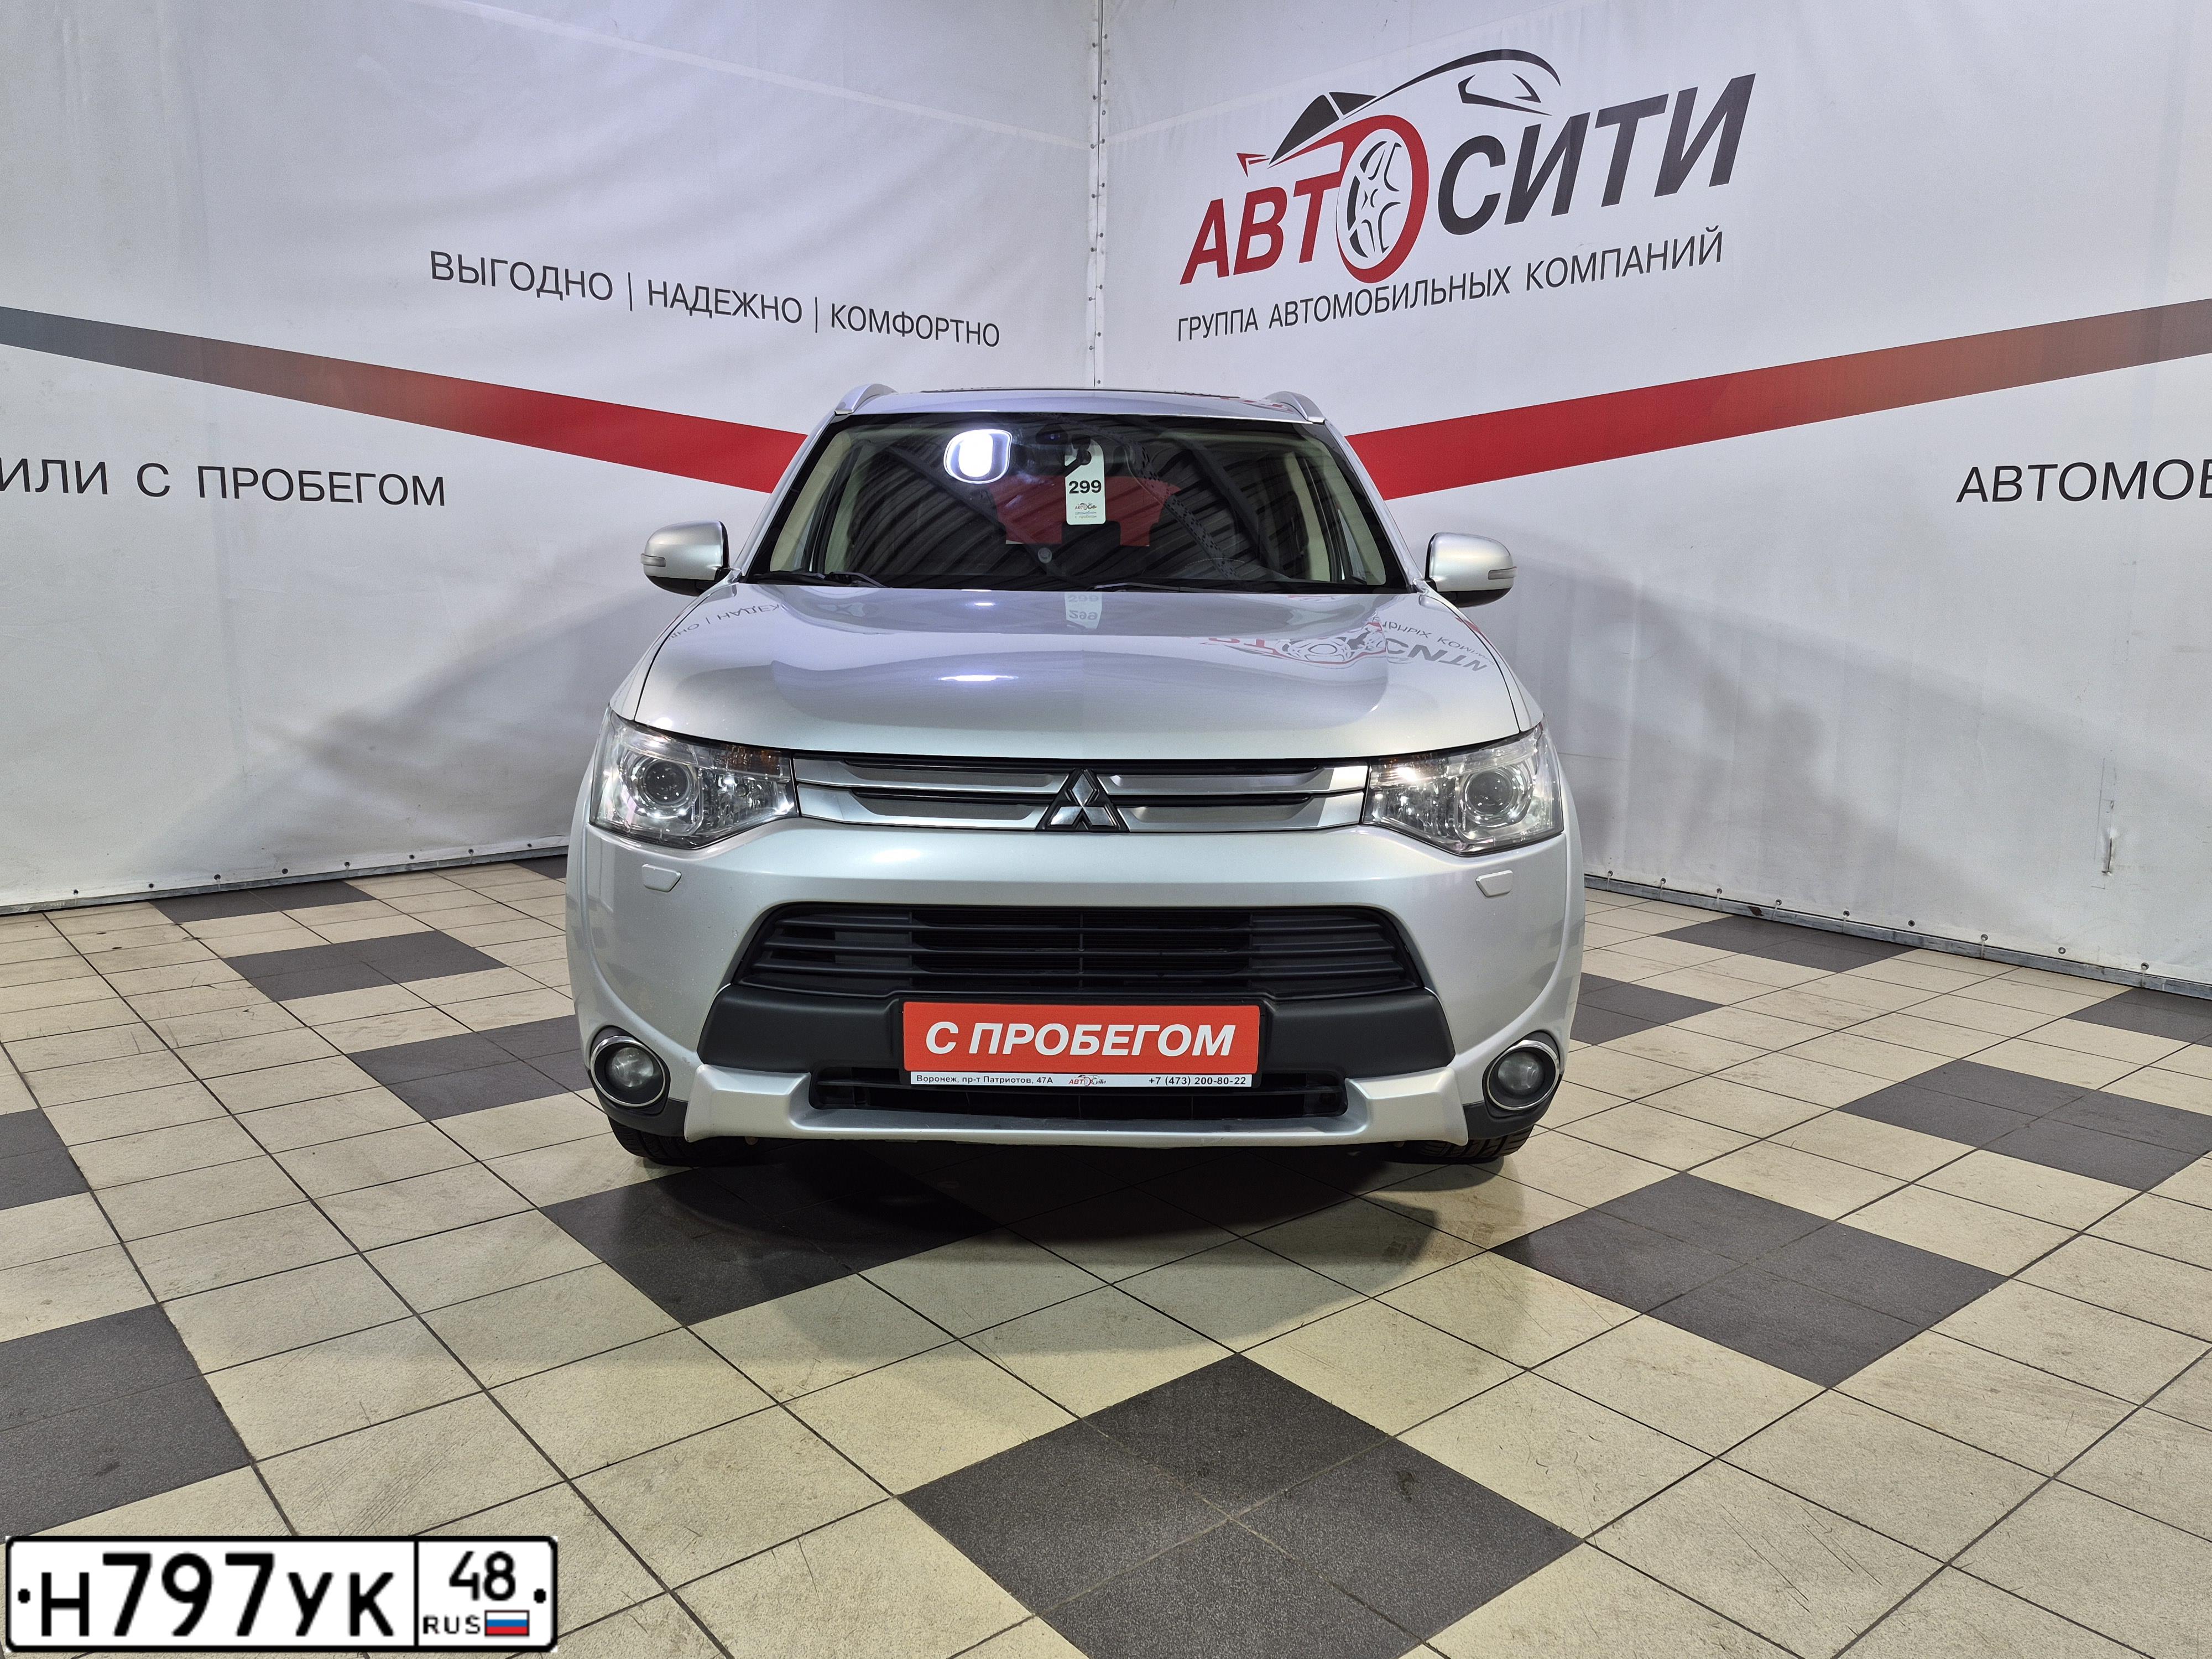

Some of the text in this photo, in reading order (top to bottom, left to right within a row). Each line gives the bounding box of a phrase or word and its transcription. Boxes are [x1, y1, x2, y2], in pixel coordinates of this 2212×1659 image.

[430, 250, 1000, 347] ВЫГОДНО НАДЕЖНО КОМФОРТНО
[1177, 225, 1724, 342] ГРУППА АВТОМОБИЛЬНЫХ КОМПАНИЙ
[137, 462, 171, 497] С
[197, 465, 445, 507] ПРОБЕГОМ
[1068, 479, 1102, 494] 299
[925, 1021, 1236, 1056] С ПРОБЕГОМ
[916, 1074, 959, 1084] Воронеж,
[983, 1076, 1034, 1084] Патриотов,
[1165, 1076, 1191, 1086] (473)
[1194, 1076, 1246, 1085] 200-80-22
